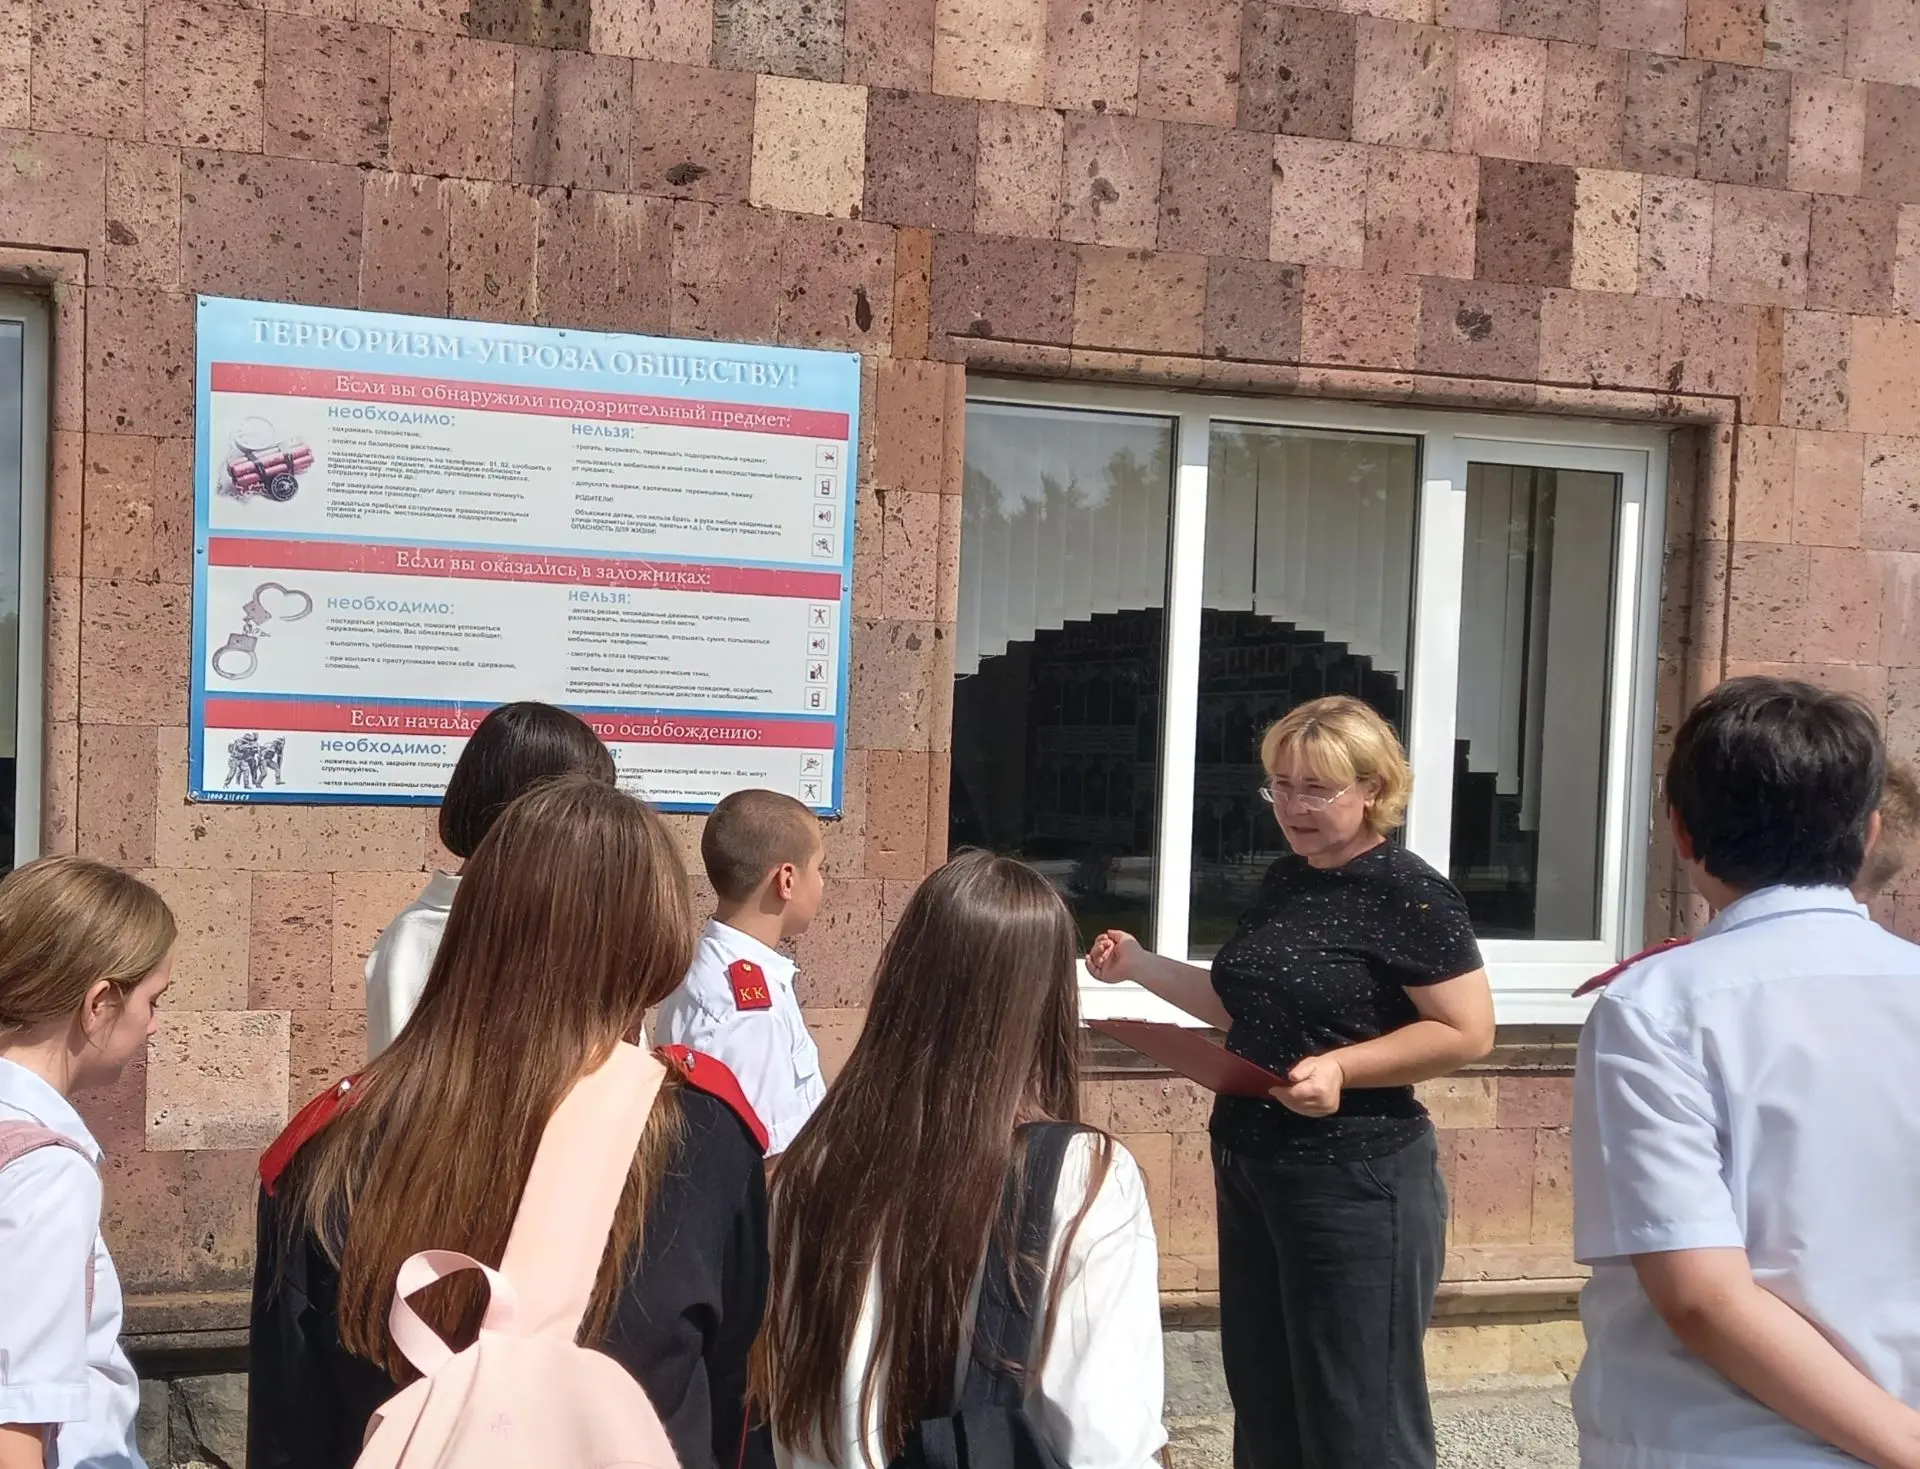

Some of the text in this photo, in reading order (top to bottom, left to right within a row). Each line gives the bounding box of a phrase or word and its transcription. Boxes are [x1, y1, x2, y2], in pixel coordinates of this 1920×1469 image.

[609, 352, 796, 389] ОБЩЕСТВУ!
[336, 375, 792, 428] Если вы обнаружили подозрительный предмет:
[328, 405, 455, 427] необходимо:
[571, 423, 635, 440] нельзя:
[396, 551, 711, 585] Если вы оказались в заложниках:
[327, 596, 455, 615] необходимо:
[568, 590, 632, 604] нельзя:
[351, 710, 481, 730] Если началас
[592, 722, 762, 741] по освобождению:
[320, 738, 447, 755] необходимо:
